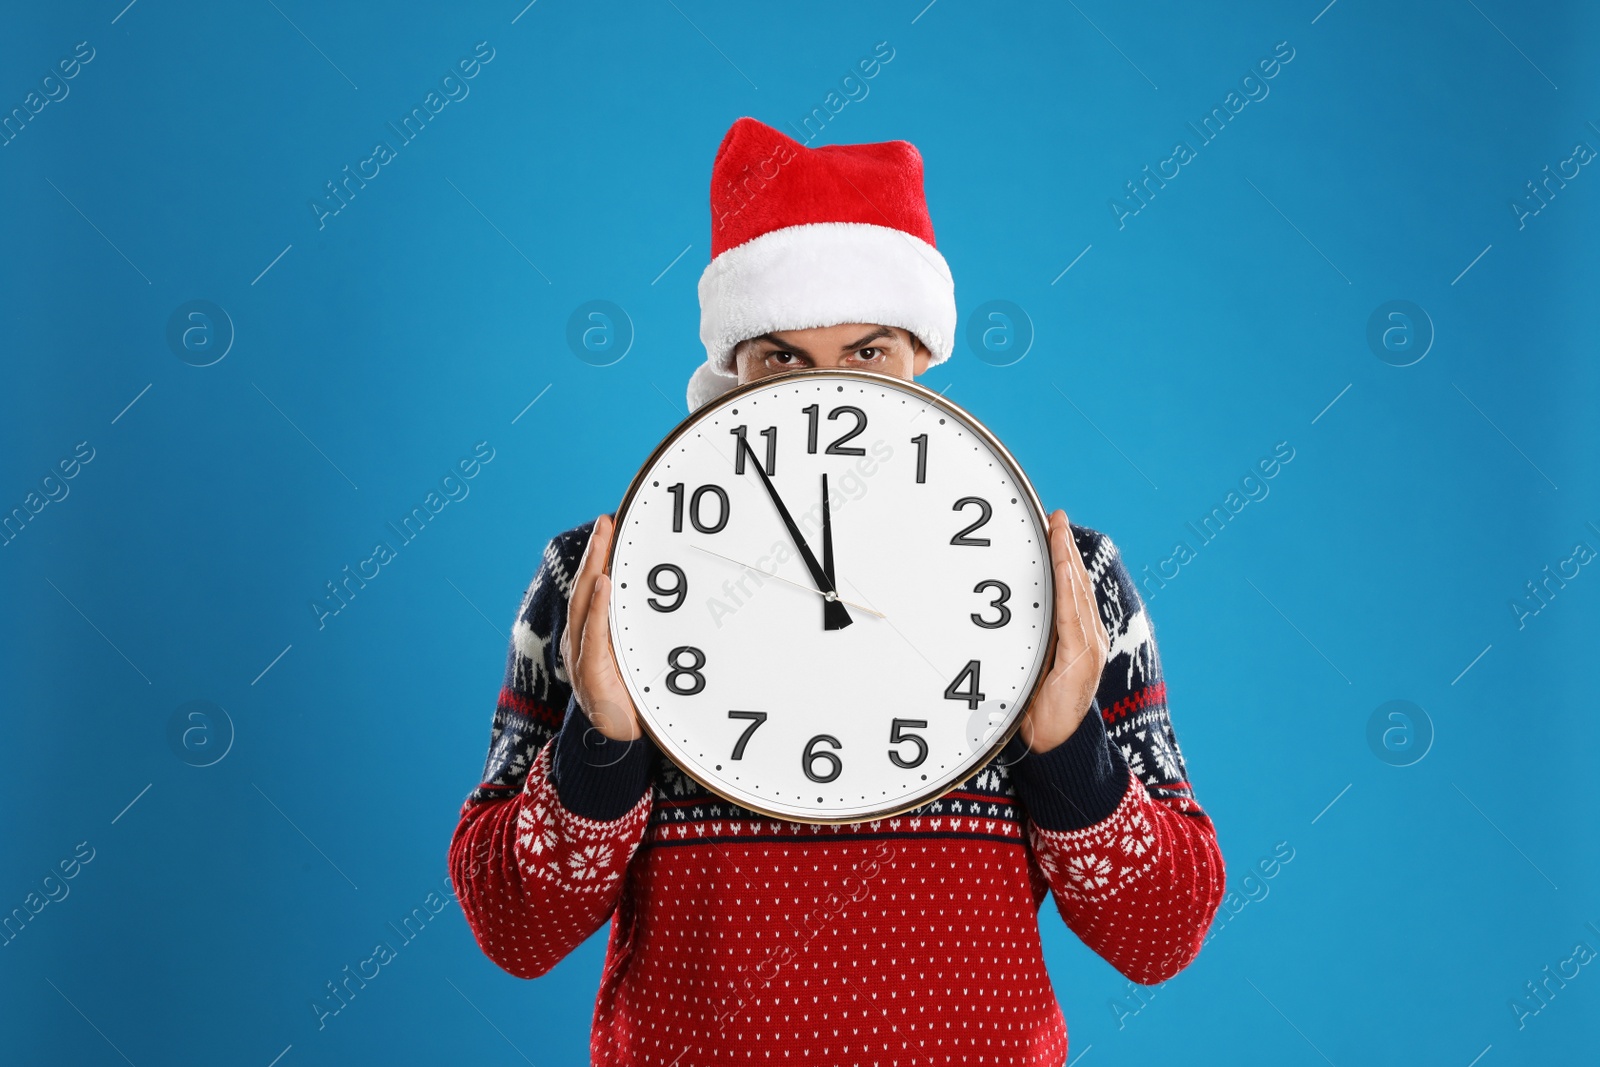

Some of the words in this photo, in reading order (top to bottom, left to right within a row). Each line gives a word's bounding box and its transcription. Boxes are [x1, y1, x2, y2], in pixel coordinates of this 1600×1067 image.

[730, 425, 777, 476] 11
[802, 404, 867, 456] 12
[911, 434, 928, 484] 1
[667, 483, 730, 534] 10
[950, 497, 992, 547] 2
[647, 563, 687, 613] 9
[971, 580, 1011, 629] 3
[666, 646, 706, 696] 8
[944, 660, 985, 710] 4
[728, 711, 767, 760] 7
[802, 734, 842, 783] 6
[888, 718, 928, 769] 5
